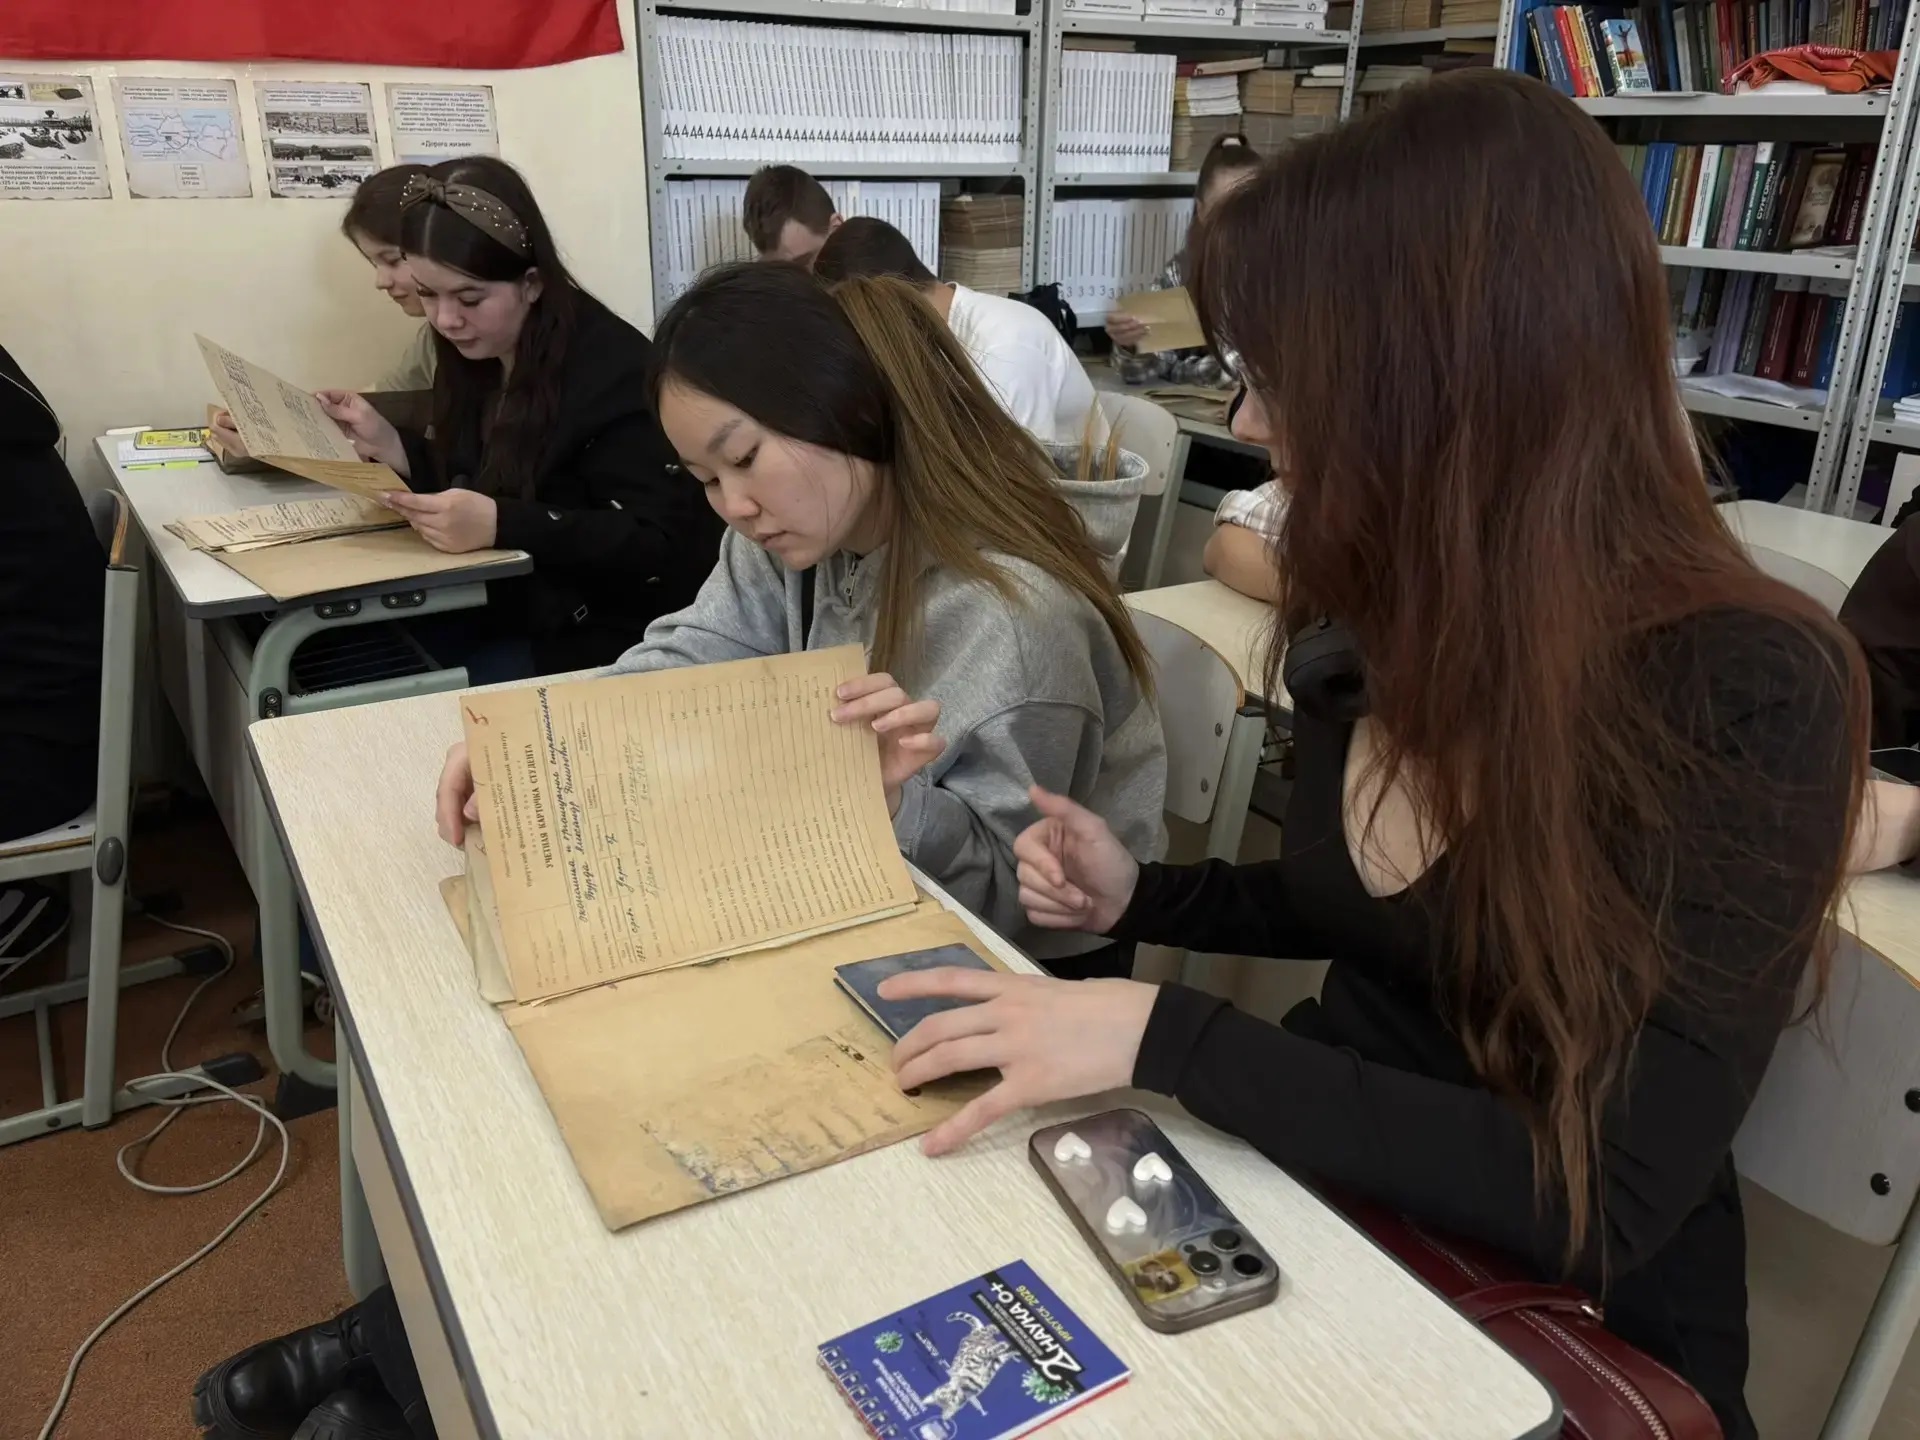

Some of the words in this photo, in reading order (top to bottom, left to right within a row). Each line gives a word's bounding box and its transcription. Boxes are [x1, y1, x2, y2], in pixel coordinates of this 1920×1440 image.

[1307, 2, 1317, 11] 5
[664, 124, 671, 137] 4
[673, 125, 680, 137] 4
[682, 125, 689, 137] 4
[690, 126, 698, 138] 4
[697, 126, 704, 138] 4
[706, 127, 714, 139] 4
[715, 127, 723, 139] 4
[724, 127, 731, 139] 4
[732, 128, 740, 140] 4
[741, 126, 749, 139] 4
[750, 128, 758, 139] 4
[759, 128, 766, 140] 4
[767, 129, 774, 140] 4
[776, 129, 783, 140] 4
[784, 129, 792, 140] 4
[793, 127, 801, 140] 4
[801, 130, 808, 141] 4
[808, 130, 816, 141] 4
[817, 130, 824, 141] 4
[824, 130, 832, 142] 4
[832, 130, 839, 142] 4
[840, 130, 848, 142] 4
[847, 129, 855, 142] 4
[855, 131, 863, 142] 4
[861, 131, 869, 142] 4
[869, 131, 877, 143] 4
[877, 131, 885, 142] 4
[883, 132, 891, 143] 4
[892, 130, 899, 143] 4
[899, 130, 906, 143] 4
[906, 132, 913, 143] 4
[913, 132, 920, 143] 4
[921, 131, 928, 144] 4
[928, 133, 935, 144] 4
[935, 132, 943, 143] 4
[942, 133, 950, 144] 4
[951, 131, 958, 144] 4
[958, 132, 965, 143] 4
[965, 133, 973, 144] 4
[973, 132, 980, 145] 4
[980, 132, 988, 145] 4
[987, 132, 995, 145] 4
[994, 132, 1001, 145] 4
[1003, 132, 1010, 145] 4
[1008, 133, 1015, 146] 4
[1015, 133, 1023, 144] 4
[523, 743, 538, 784] СТУДЕНТА
[531, 786, 546, 828] КАРТОЧКА
[539, 831, 554, 868] УЧЕТНАЯ
[1014, 1281, 1040, 1307] 2026
[1007, 1299, 1060, 1355] НАУКА
[1035, 1303, 1074, 1343] ИРКУТСК
